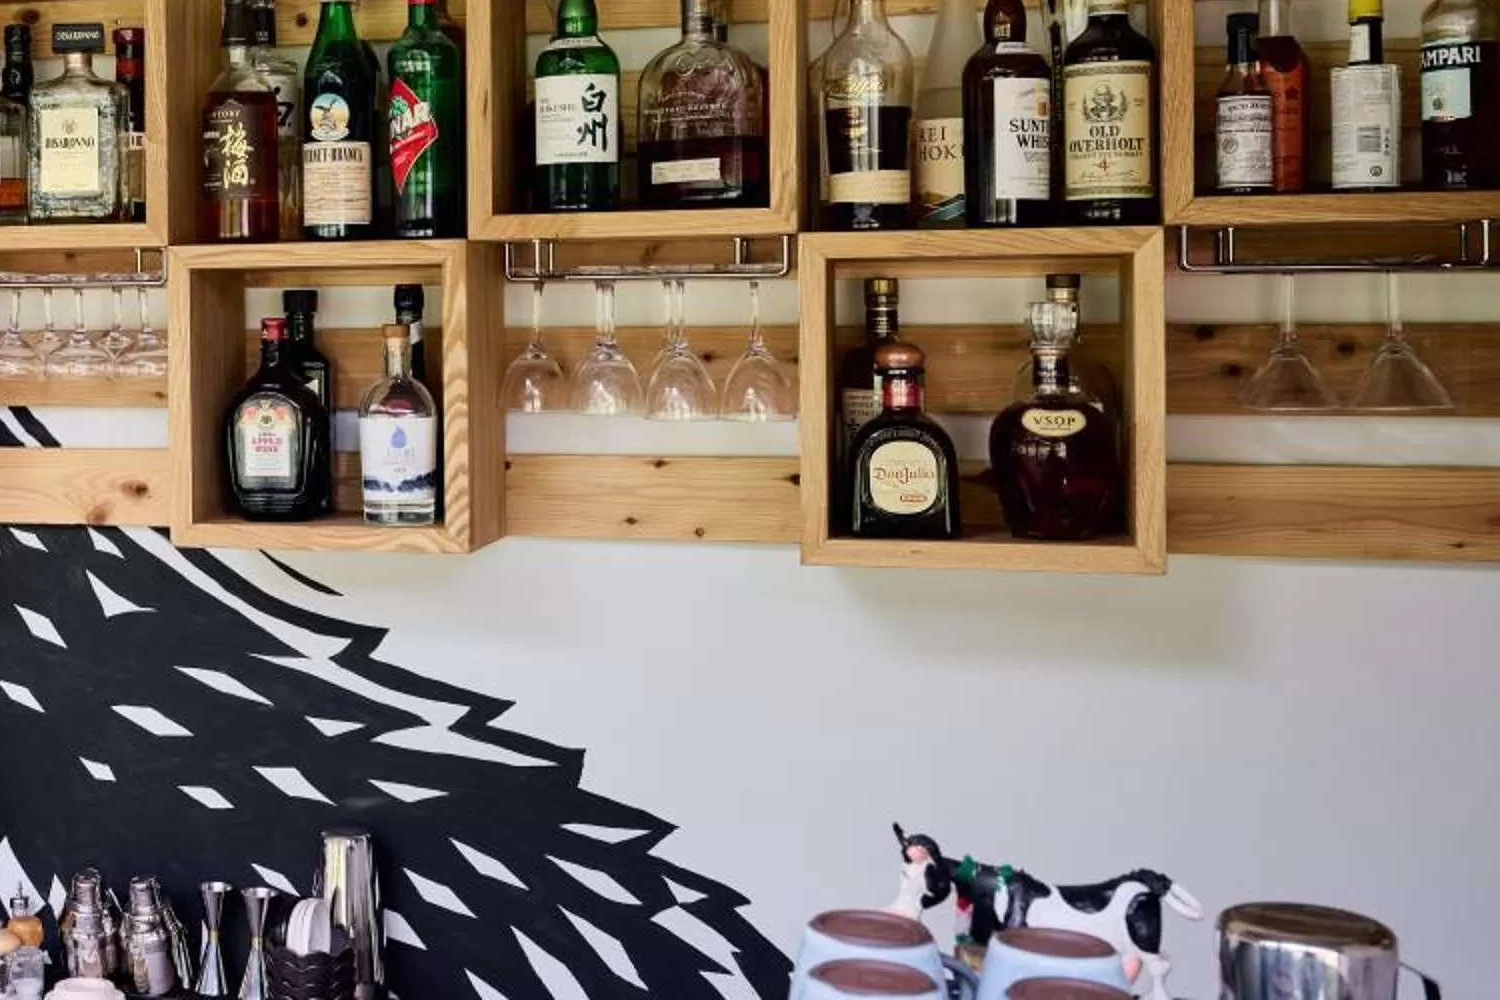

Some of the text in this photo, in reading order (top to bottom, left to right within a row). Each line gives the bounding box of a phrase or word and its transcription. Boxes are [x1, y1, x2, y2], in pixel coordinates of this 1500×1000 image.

[1421, 45, 1481, 68] AMPARI
[577, 82, 608, 152] 白州
[1009, 119, 1049, 132] SUNT
[1089, 126, 1120, 138] OLD
[45, 137, 95, 149] DISARONNO
[1069, 138, 1145, 152] OVERHOLT
[219, 121, 254, 189] 梅酒
